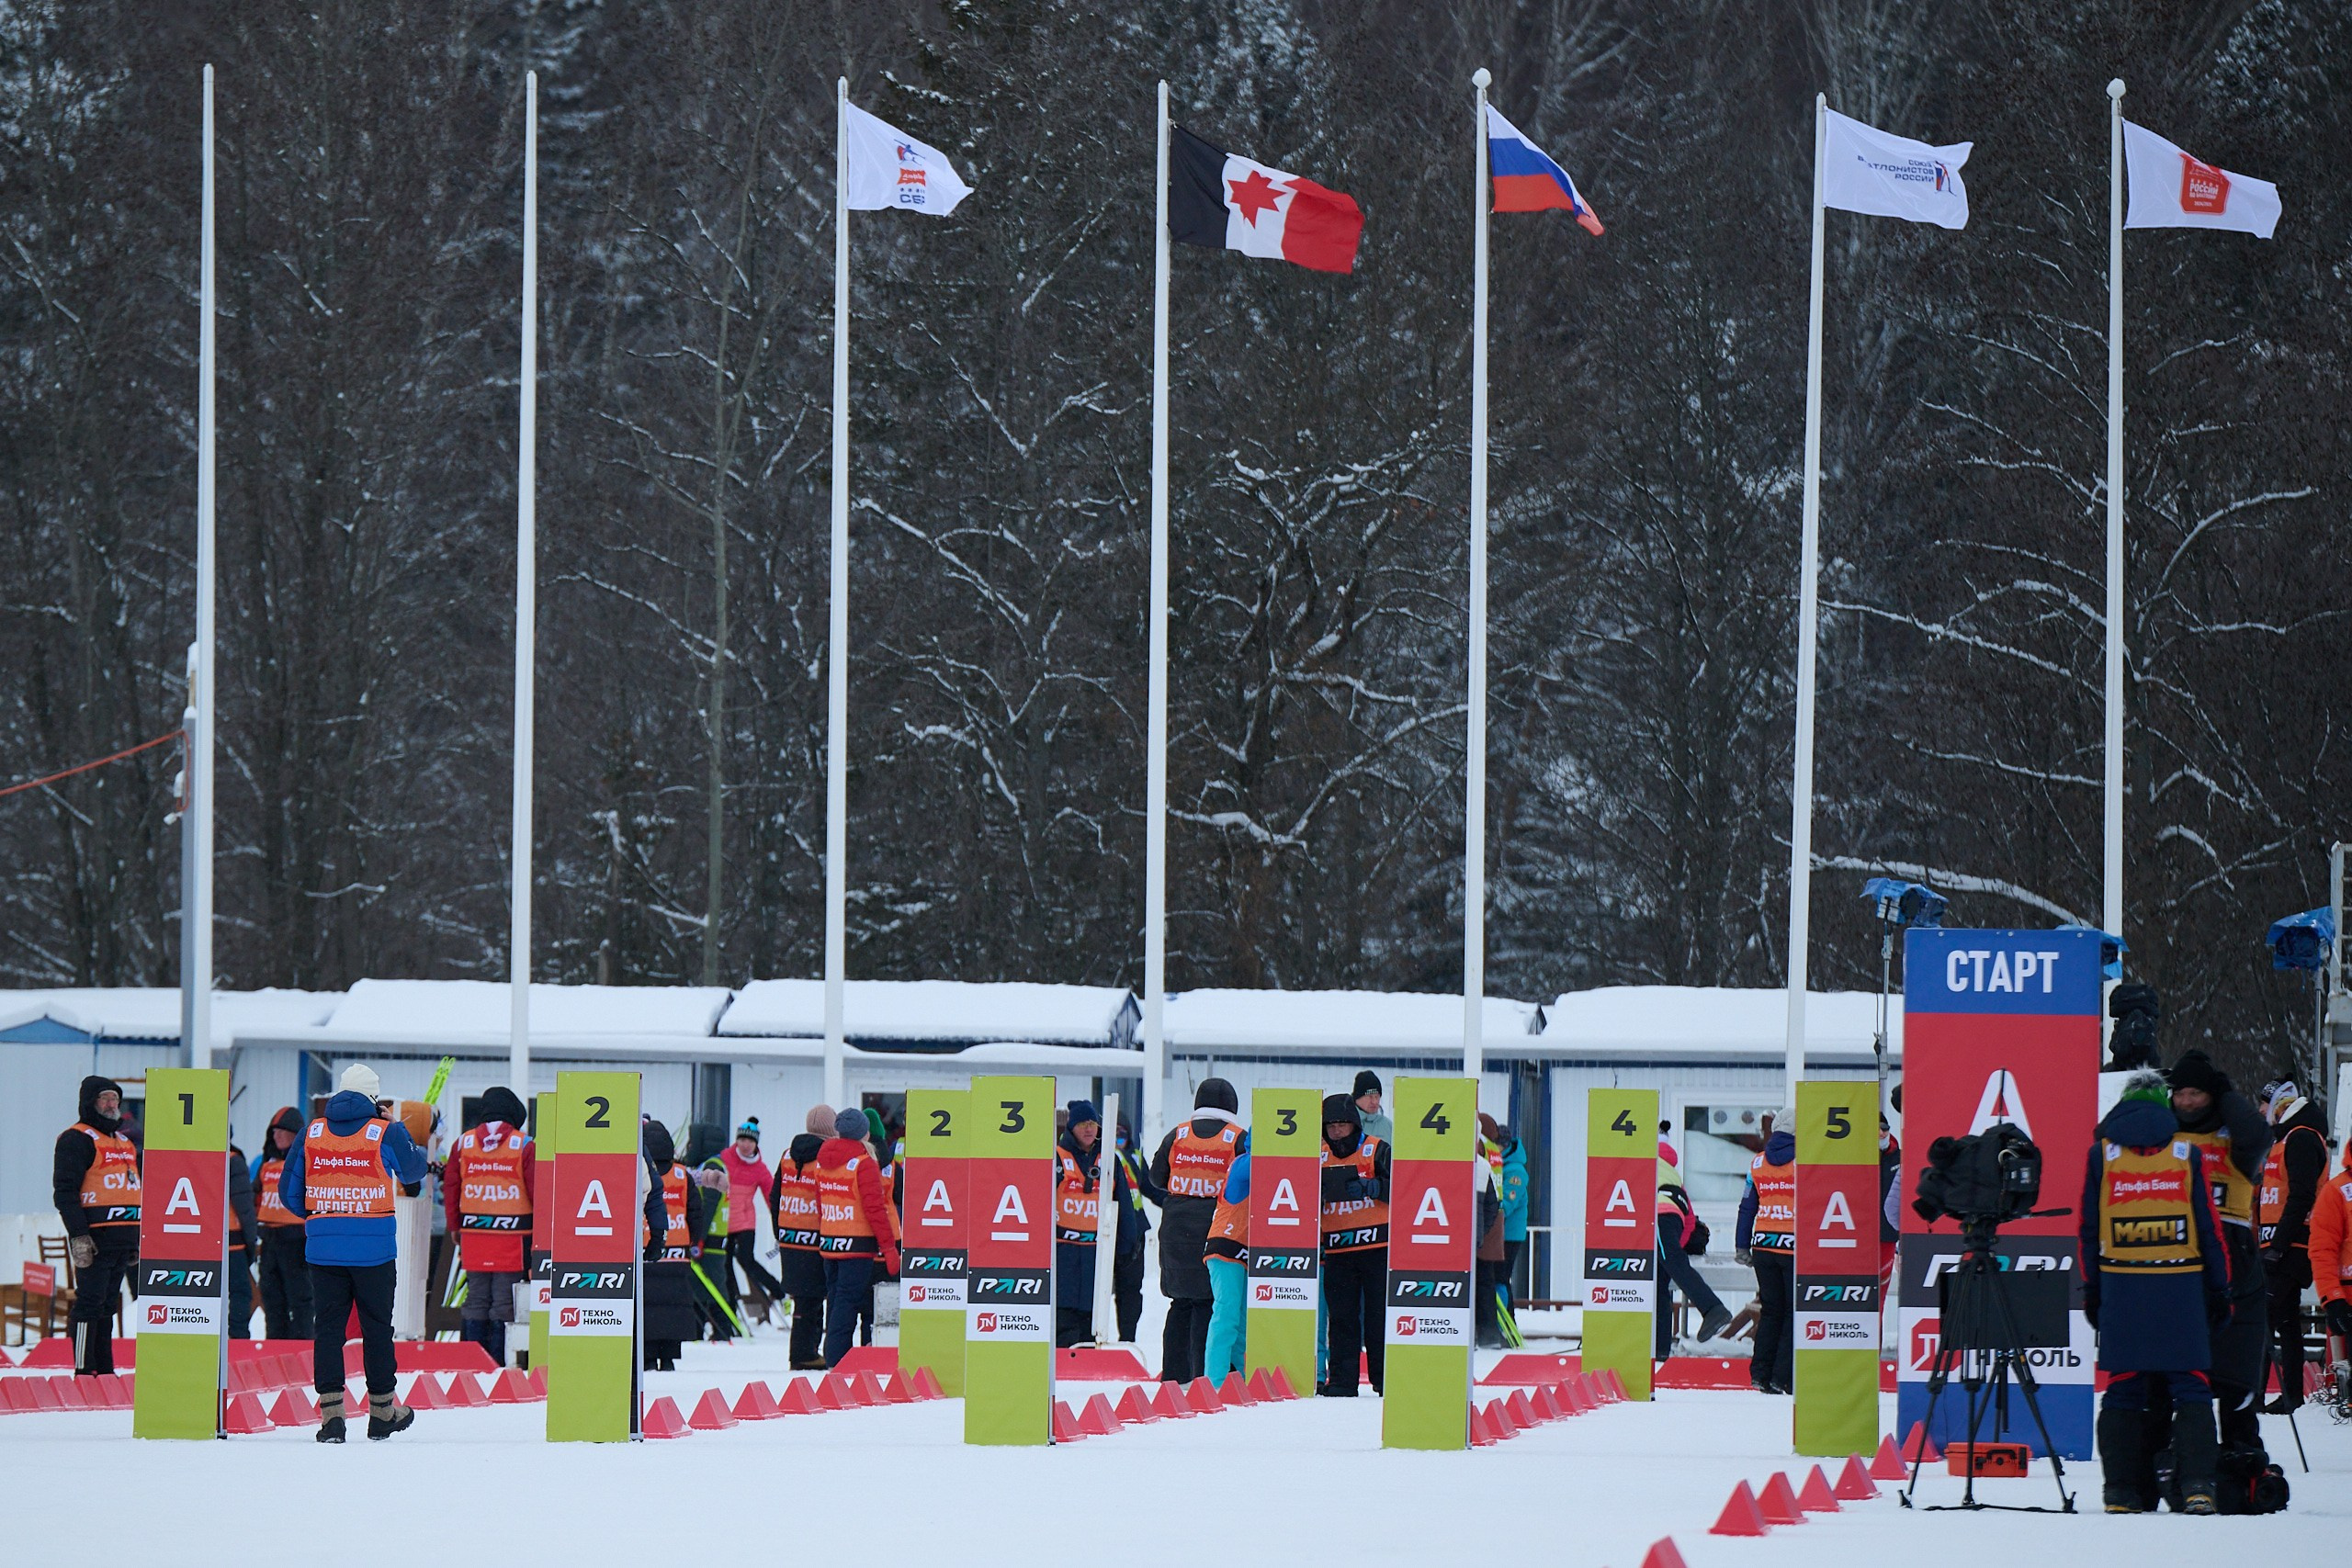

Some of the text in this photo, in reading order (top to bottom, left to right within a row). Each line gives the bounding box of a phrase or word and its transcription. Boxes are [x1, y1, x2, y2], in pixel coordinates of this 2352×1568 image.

[1894, 173, 1934, 182] РОССИИ
[1946, 949, 2060, 994] СТАРТ
[178, 1093, 194, 1125] 1
[584, 1096, 610, 1128] 2
[930, 1110, 952, 1137] 2
[999, 1100, 1025, 1134] 3
[1275, 1109, 1298, 1136] 3
[1419, 1102, 1451, 1135] 4
[1611, 1109, 1637, 1136] 4
[1824, 1106, 1852, 1140] 5
[313, 1156, 370, 1168] Альфа Банк
[1175, 1152, 1225, 1166] Альфа Банк
[468, 1162, 514, 1172] Альфа Банк
[464, 1183, 520, 1201] СУДЬЯ
[832, 1182, 849, 1192] Банк
[2113, 1179, 2180, 1193] Альфа Банк
[81, 1191, 97, 1204] 72
[779, 1195, 819, 1215] СУДЬЯ
[1063, 1197, 1098, 1218] СУД
[462, 1214, 520, 1229] PARI
[1224, 1223, 1235, 1235] 2
[1063, 1229, 1098, 1242] PA
[1329, 1227, 1378, 1247] PARI
[2113, 1219, 2186, 1243] МАТЧ!
[909, 1256, 964, 1271] PARI
[1255, 1255, 1311, 1270] PARI
[1590, 1257, 1647, 1272] PARI
[147, 1269, 213, 1287] PARI
[560, 1272, 626, 1289] PARI
[976, 1277, 1043, 1294] PARI
[1396, 1280, 1463, 1298] PARI
[1804, 1285, 1871, 1302] PARI
[169, 1307, 202, 1315] ТЕХНО
[582, 1309, 614, 1317] ТЕХНО
[999, 1314, 1032, 1323] ТЕХНО
[170, 1315, 210, 1325] НИКОЛЬ
[1000, 1323, 1040, 1331] НИКОЛЬ
[1827, 1323, 1860, 1331] ТЕХНО
[1419, 1326, 1459, 1335] НИКОЛЬ
[1829, 1331, 1869, 1339] НИКОЛЬ
